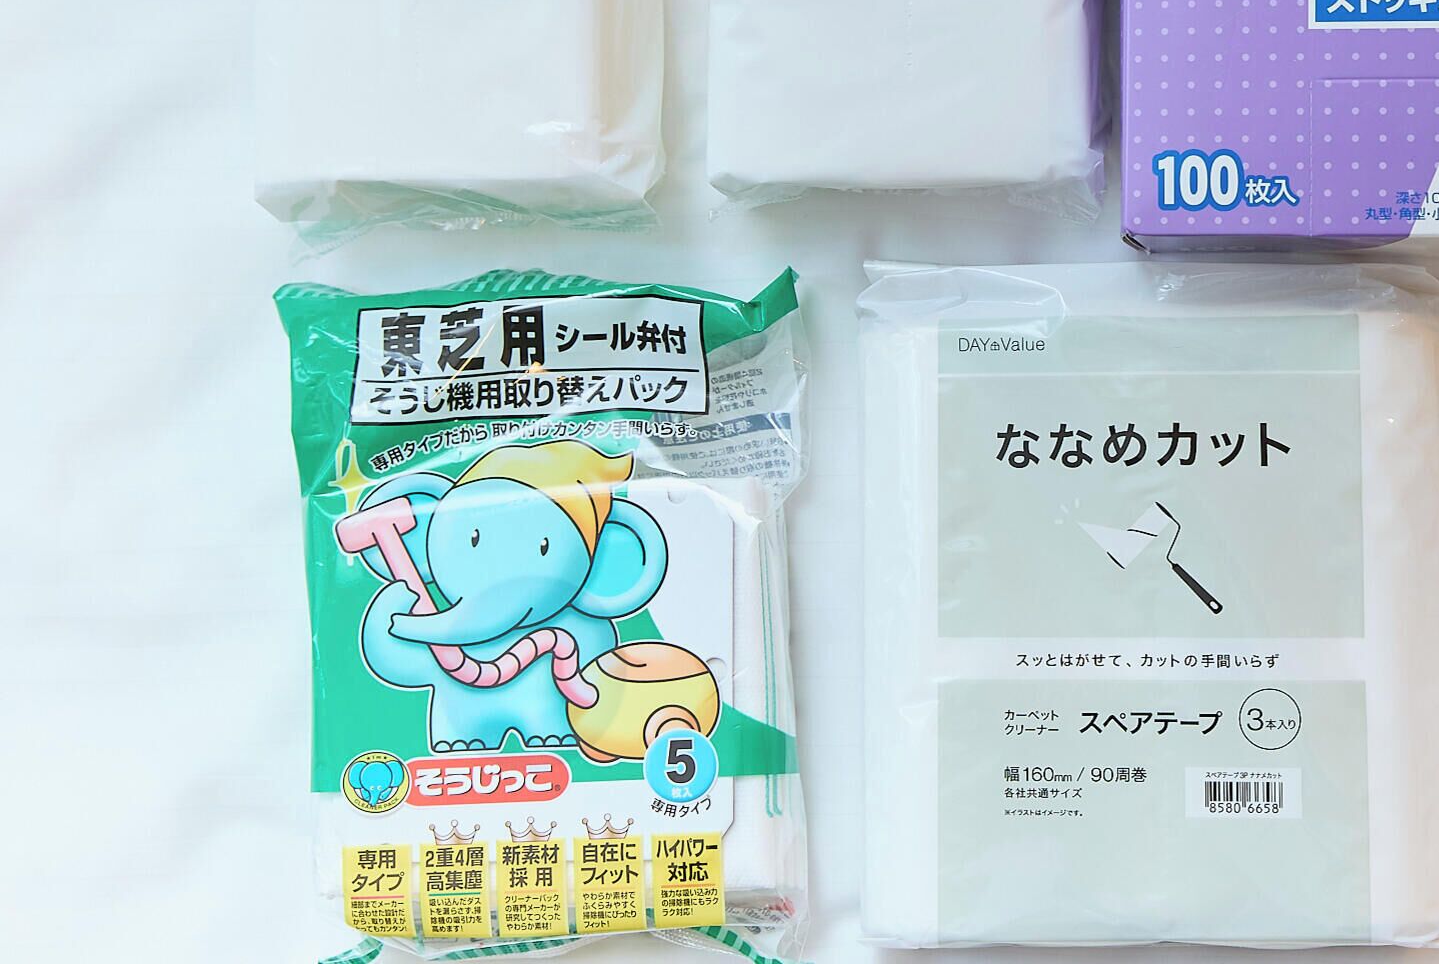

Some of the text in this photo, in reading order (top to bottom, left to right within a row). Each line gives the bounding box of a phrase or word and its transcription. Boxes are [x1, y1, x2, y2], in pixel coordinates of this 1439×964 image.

[380, 304, 687, 378] 東芝用 シール弁付
[369, 374, 688, 416] そうじ機用取り替えパック
[996, 422, 1291, 469] ななめカット
[1004, 709, 1060, 721] カーペット
[1079, 710, 1223, 735] スペアテープ
[1246, 707, 1297, 732] 3本入り
[1004, 723, 1060, 736] クリーナー
[666, 739, 696, 784] 5
[1090, 766, 1148, 783] 90周巻
[1004, 787, 1083, 799] 各社共通サイズ
[650, 794, 711, 818] 専用タイプ
[425, 845, 484, 867] 2重4層
[502, 844, 559, 864] 新素材
[581, 842, 636, 863] 自在に
[656, 838, 718, 858] ハイパワー
[357, 850, 397, 868] 専用
[426, 868, 483, 891] 高集塵
[581, 866, 639, 886] フィット
[667, 861, 709, 882] 対応
[352, 872, 404, 893] タイプ
